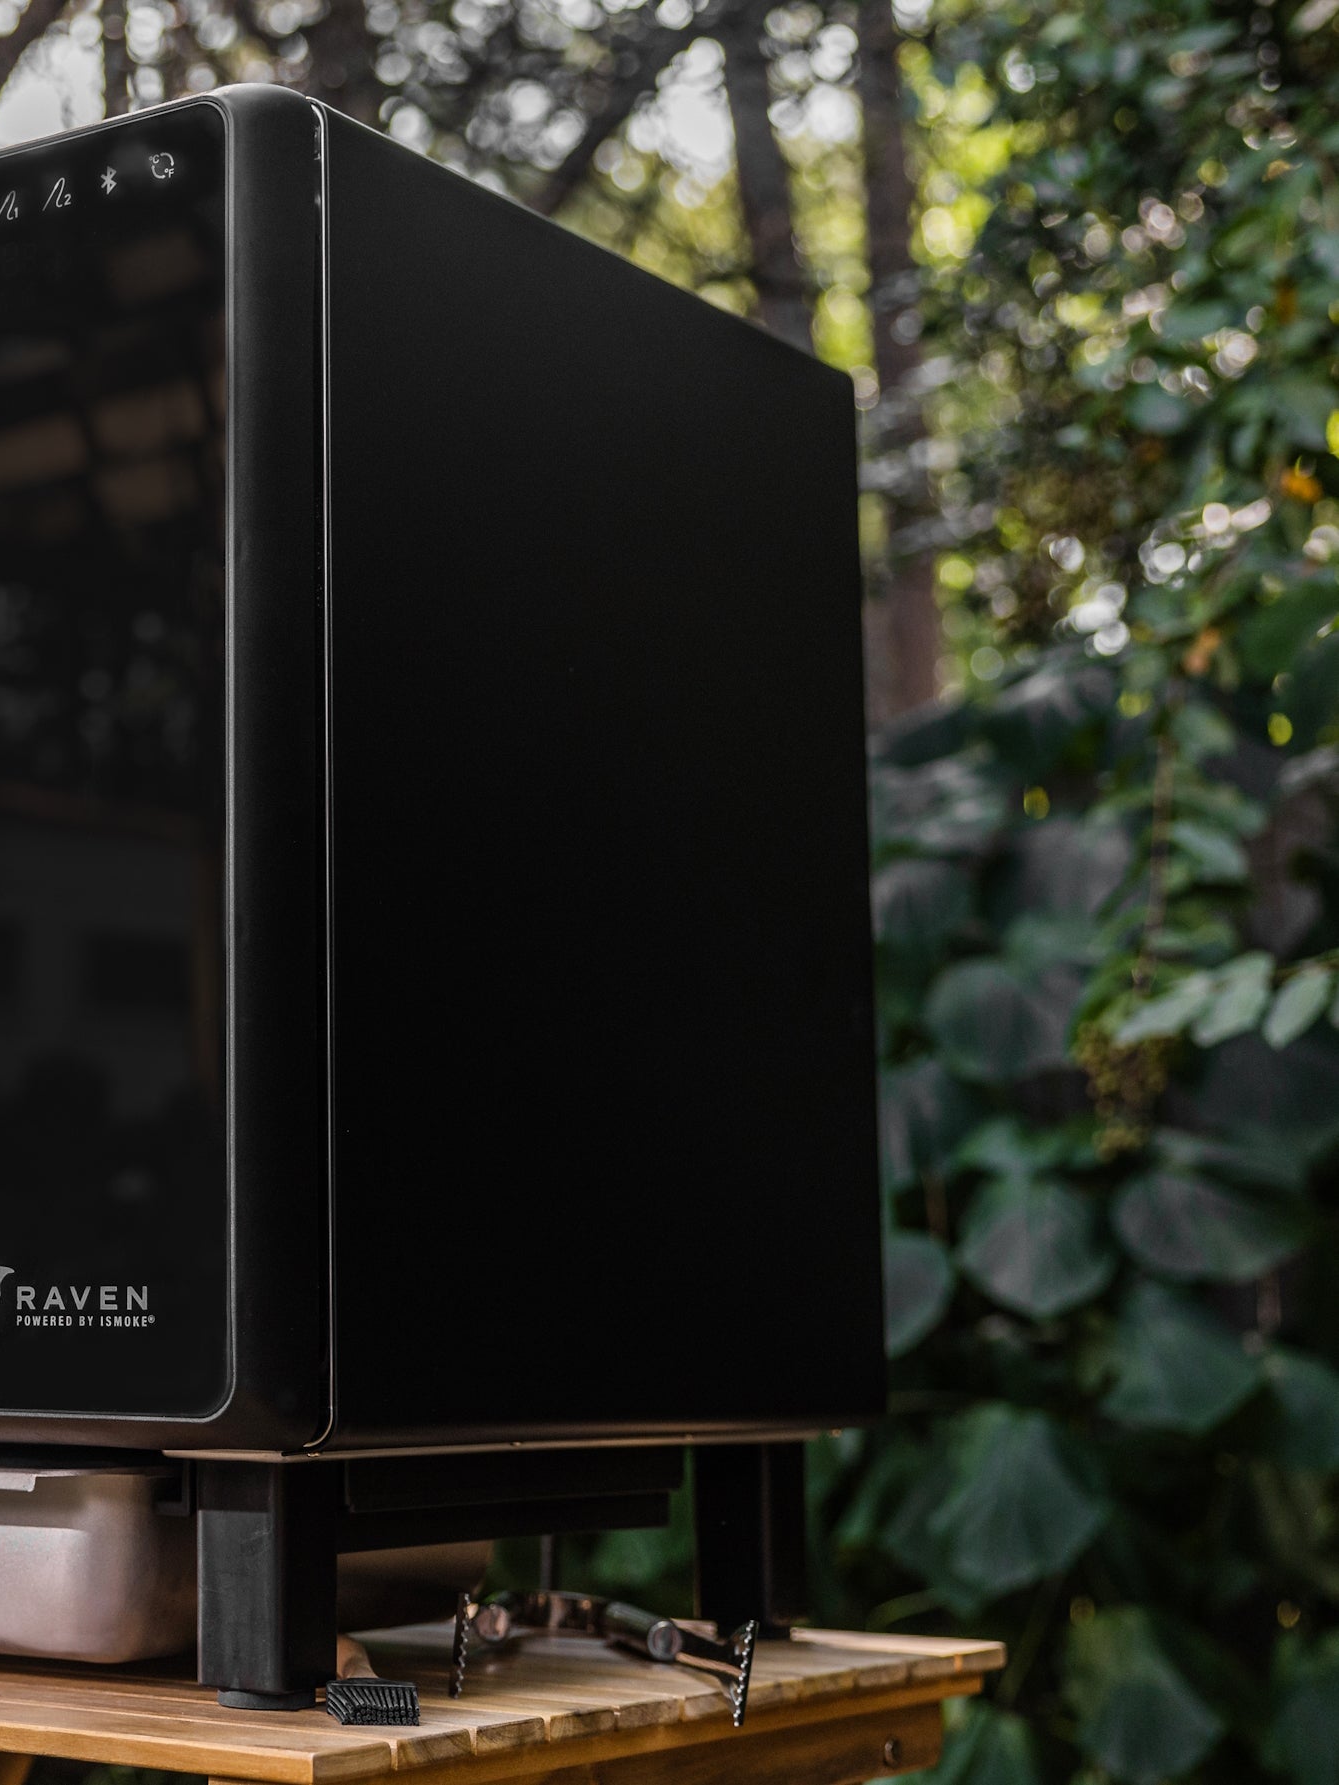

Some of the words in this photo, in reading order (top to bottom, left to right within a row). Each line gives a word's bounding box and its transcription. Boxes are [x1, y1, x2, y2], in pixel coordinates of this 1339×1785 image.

[64, 193, 72, 206] 2
[14, 207, 19, 218] 1
[16, 1286, 148, 1310] RAVEN
[16, 1315, 73, 1327] POWERED
[79, 1315, 94, 1327] BY
